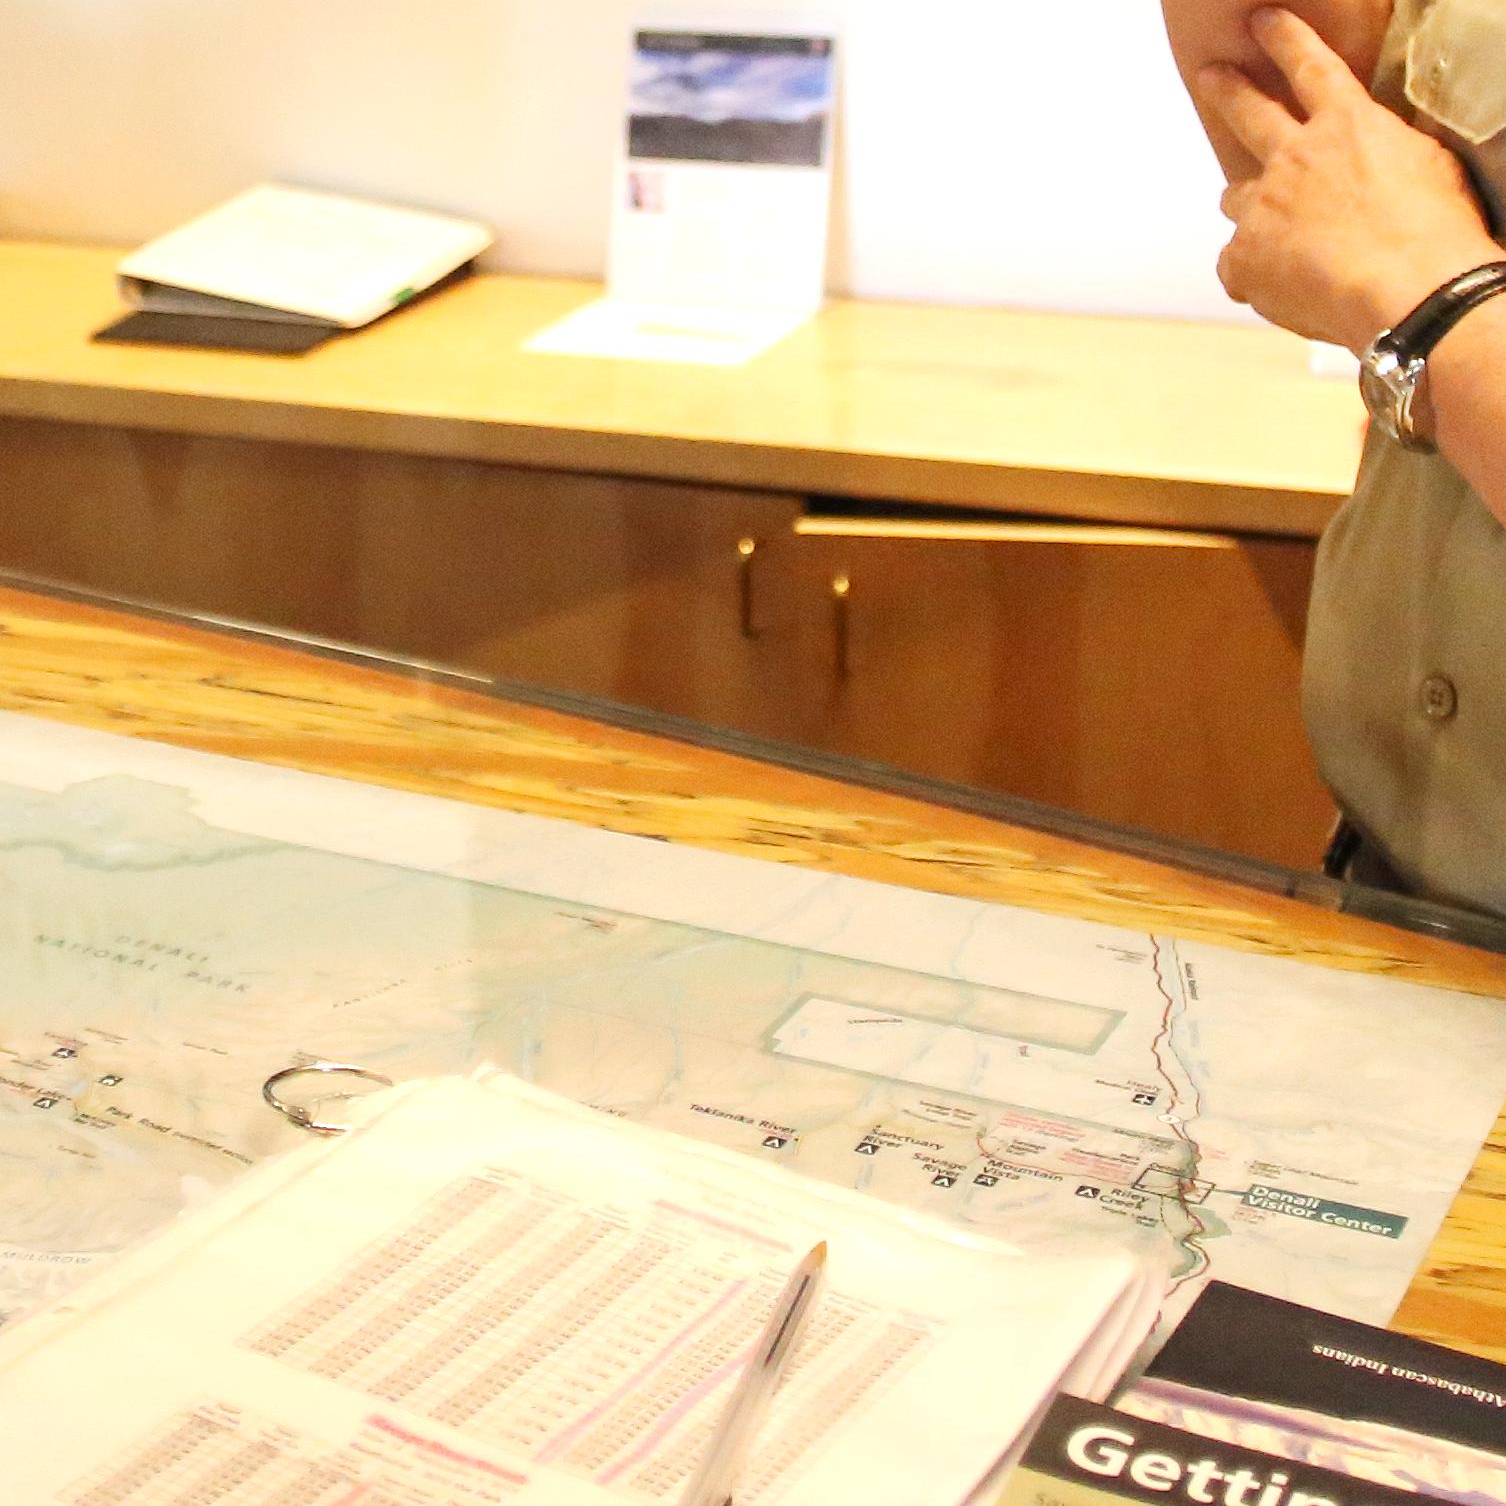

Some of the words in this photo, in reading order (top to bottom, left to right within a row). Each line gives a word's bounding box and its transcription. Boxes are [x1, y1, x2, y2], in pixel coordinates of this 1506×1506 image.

[105, 1106, 133, 1120] Park
[138, 1118, 172, 1134] Road
[688, 1102, 755, 1125] Teklanika
[758, 1119, 797, 1134] River
[871, 1124, 944, 1151] Sanctuary
[911, 1152, 968, 1172] Savage
[921, 1163, 962, 1177] River
[983, 1166, 1021, 1181] Vista
[987, 1159, 1064, 1182] Mountain
[1099, 1195, 1143, 1211] Creek
[1111, 1188, 1149, 1204] Riley
[1251, 1186, 1321, 1209] Denali
[1247, 1195, 1317, 1219] Visitor
[1320, 1212, 1393, 1236] Center
[1311, 1344, 1389, 1375] Indians
